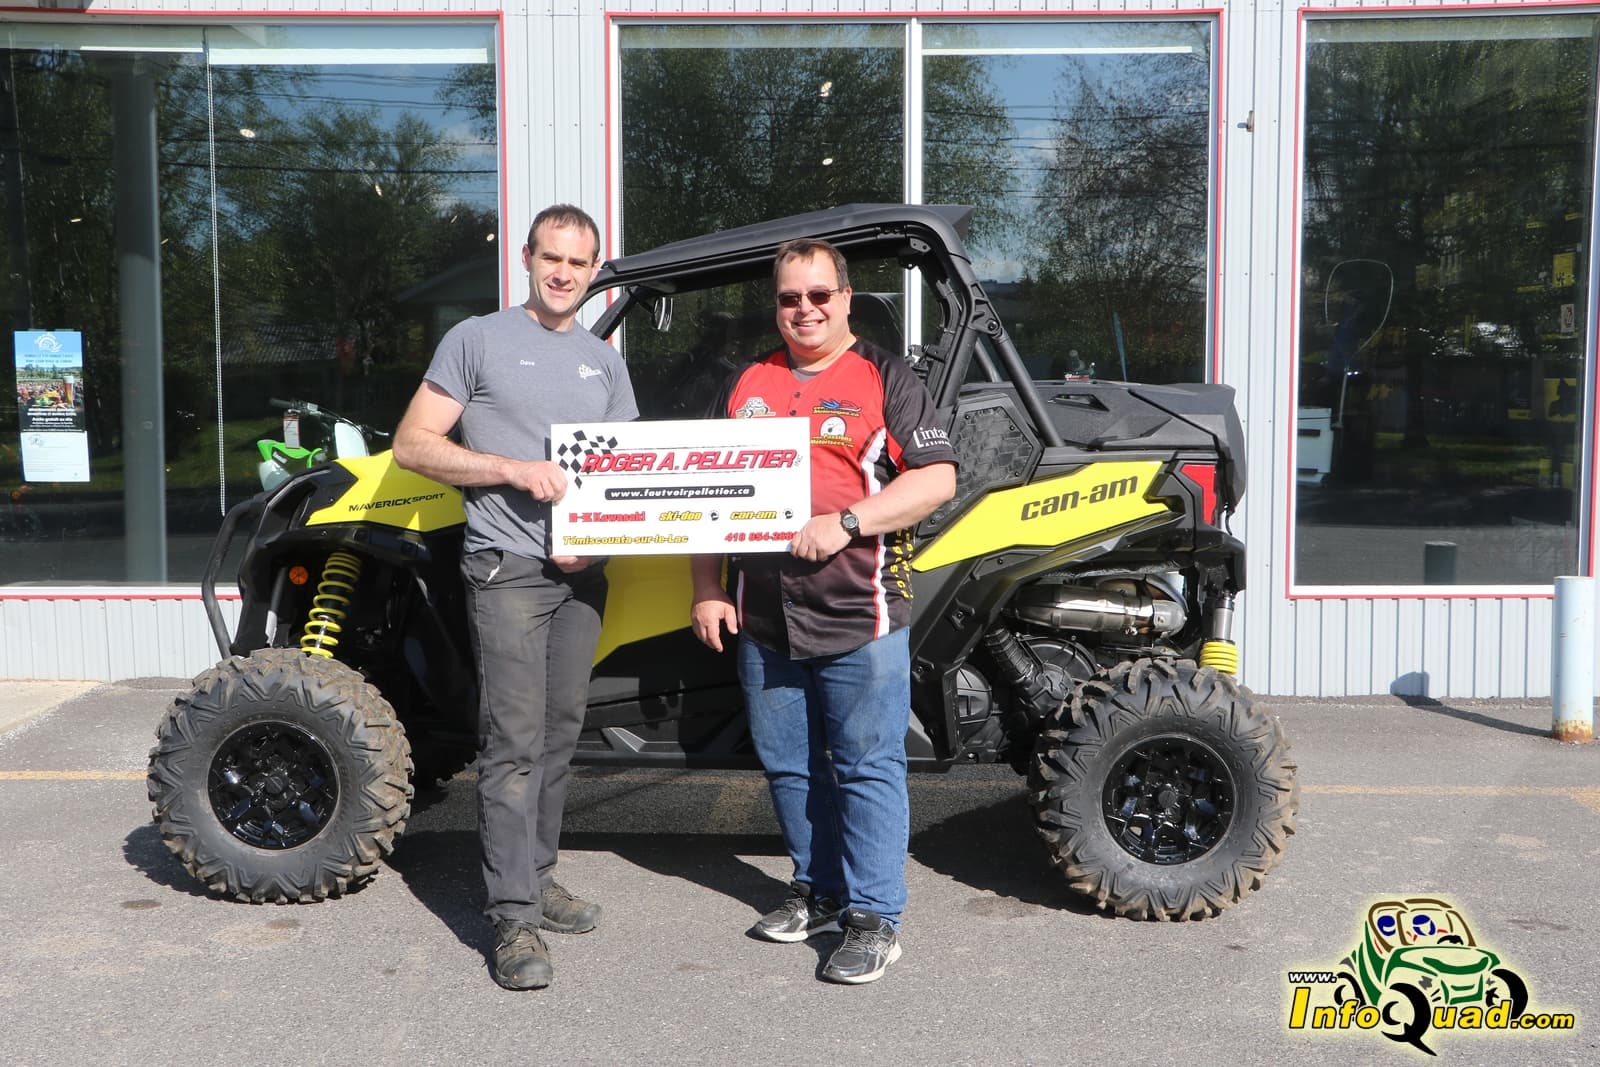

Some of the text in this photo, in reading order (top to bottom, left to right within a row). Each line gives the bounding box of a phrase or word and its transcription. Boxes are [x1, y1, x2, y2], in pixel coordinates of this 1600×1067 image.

[580, 453, 658, 474] ROGER
[656, 451, 680, 471] A.
[682, 449, 798, 470] PELLETIER
[610, 487, 751, 498] www.fautvoirpelletier.ca
[1021, 475, 1138, 522] can-am
[348, 497, 412, 512] MAVERICK
[593, 511, 645, 521] Kawasaki
[659, 511, 702, 521] ski-doo
[730, 511, 777, 520] can-am
[724, 532, 746, 542] 418
